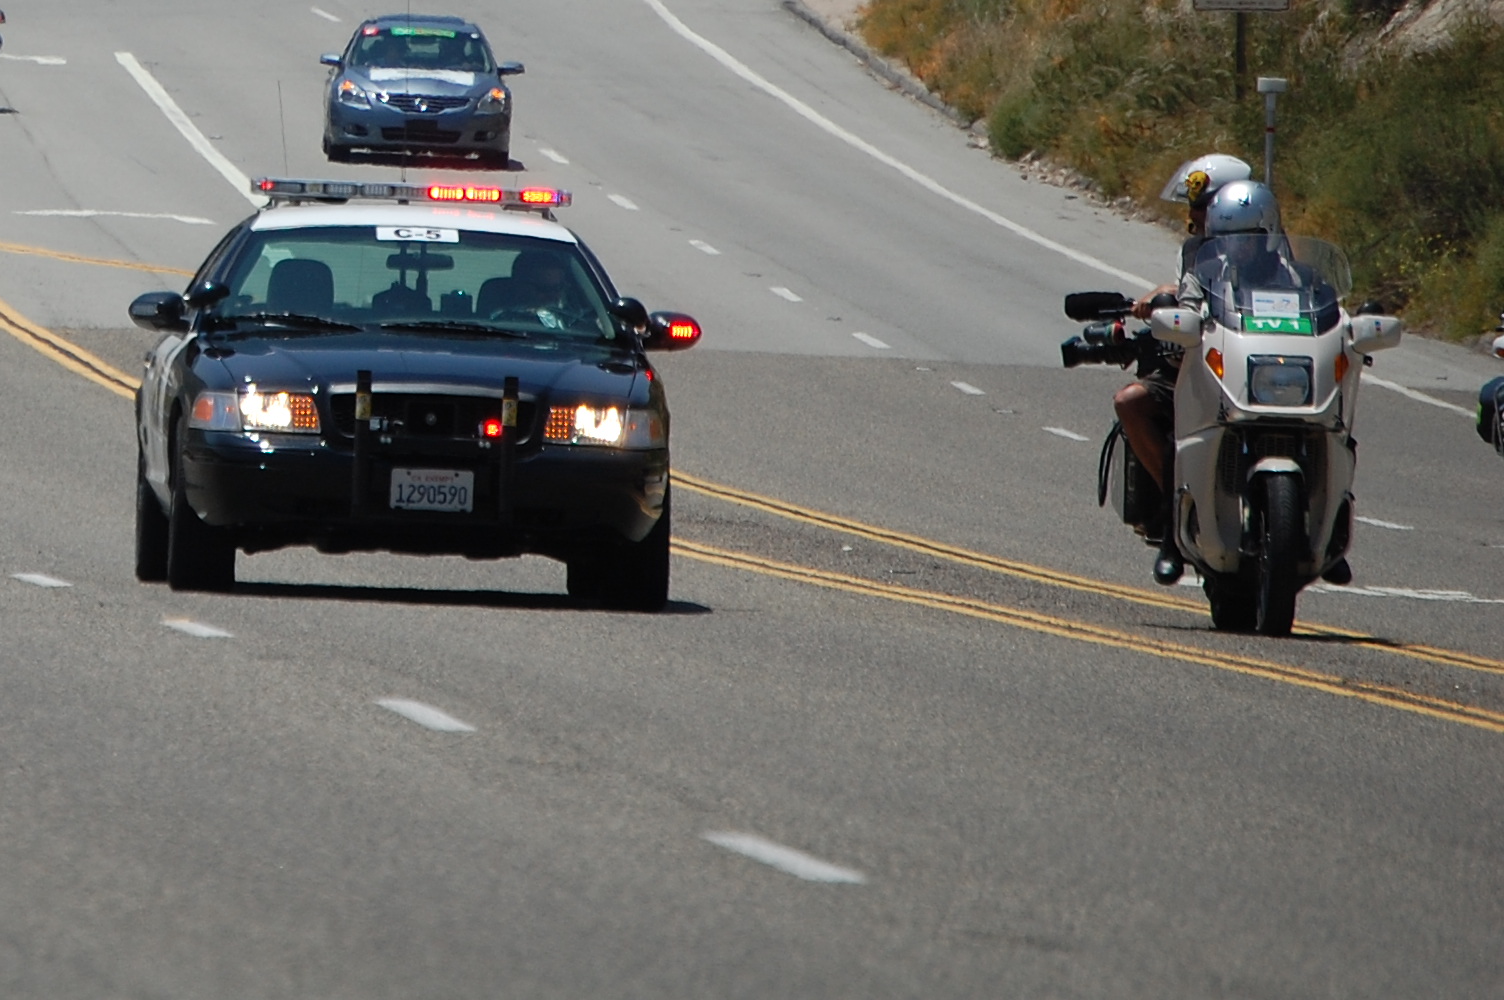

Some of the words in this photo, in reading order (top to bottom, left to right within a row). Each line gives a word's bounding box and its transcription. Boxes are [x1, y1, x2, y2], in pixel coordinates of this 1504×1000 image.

[394, 228, 441, 240] C-5
[1252, 319, 1282, 329] TV
[1289, 320, 1300, 330] 1
[395, 483, 468, 506] 1290590
